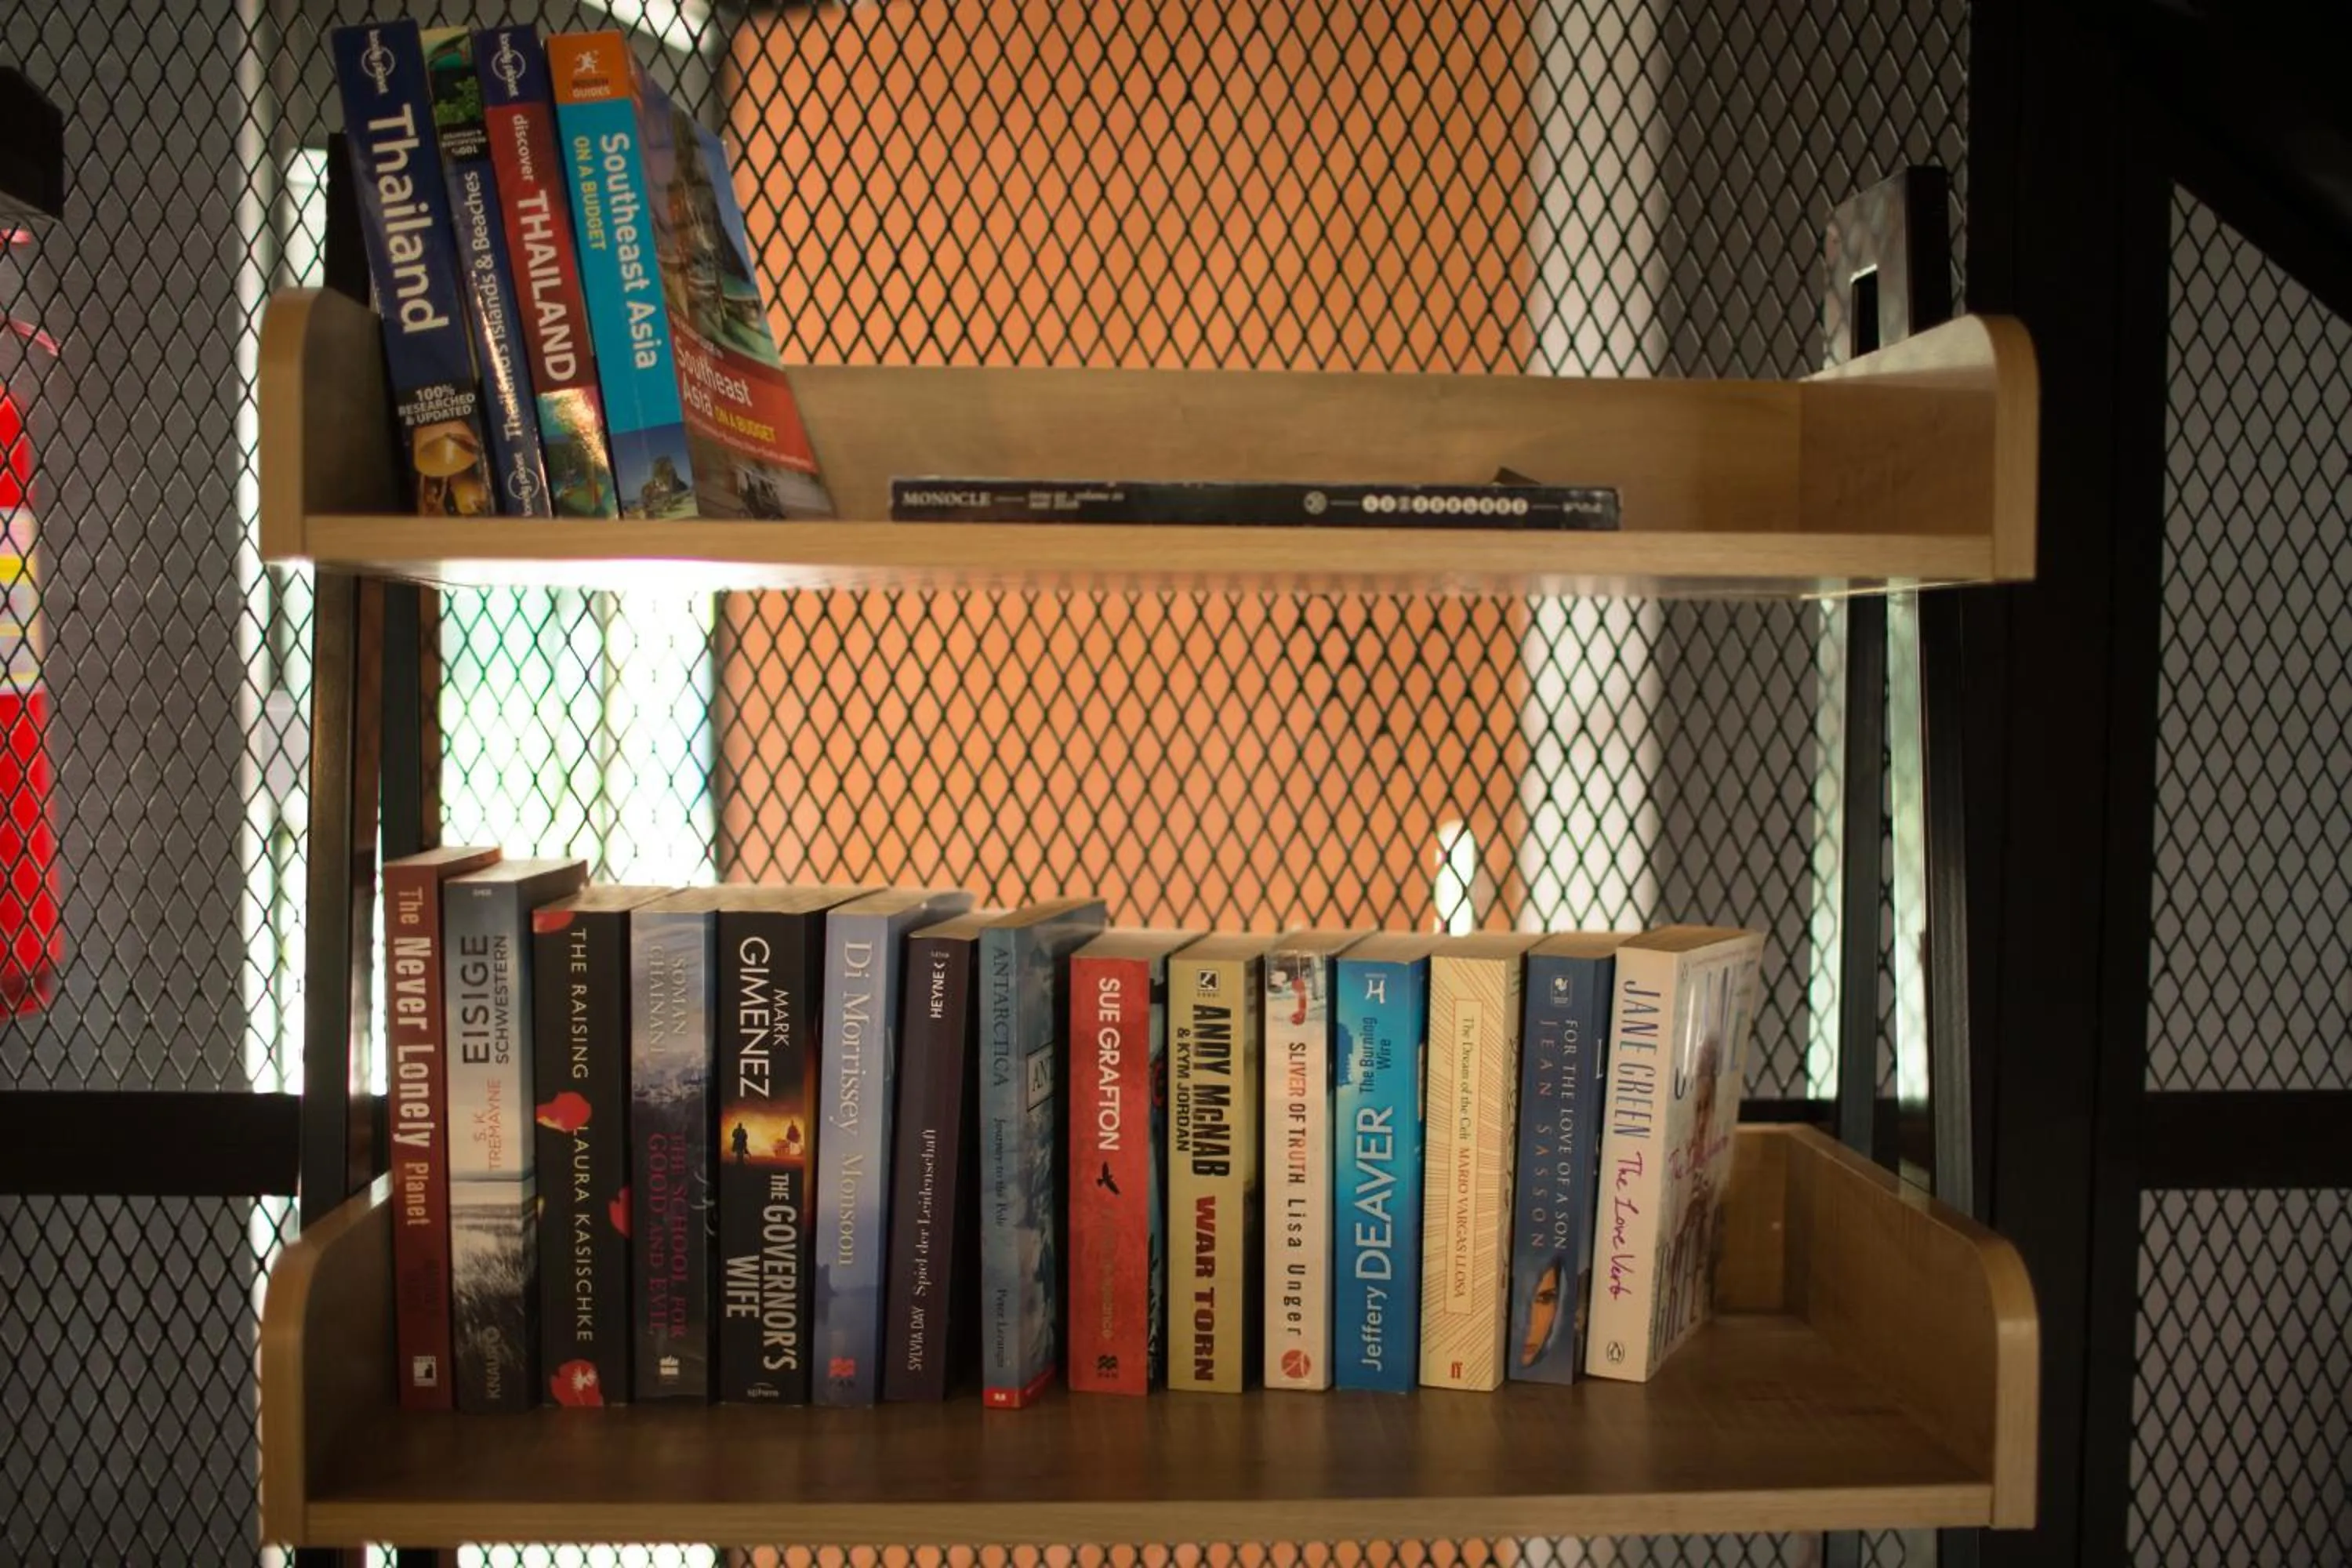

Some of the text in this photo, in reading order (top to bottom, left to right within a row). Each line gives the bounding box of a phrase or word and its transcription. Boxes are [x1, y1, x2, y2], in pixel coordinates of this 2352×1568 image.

[572, 87, 611, 98] GUIDES
[513, 114, 534, 181] discover
[573, 136, 607, 251] ON A BUDGET
[368, 103, 450, 333] Thailand
[600, 132, 661, 369] Southeast Asia
[464, 171, 523, 441] Thailands Islands & Beaches
[517, 189, 576, 382] THAILAND
[398, 393, 475, 417] RESEARCHED
[416, 383, 456, 402] 100%
[416, 405, 472, 423] UPDATED
[675, 336, 753, 407] Southeast
[683, 372, 713, 416] Asia
[902, 492, 992, 507] MONOCLE
[398, 887, 423, 925] The
[394, 937, 432, 1030] Never
[461, 935, 490, 1065] EISIGE
[493, 935, 510, 1065] SCHWESTERN
[571, 928, 589, 1080] THE RAISING
[649, 945, 666, 1054] CHAINANI
[671, 957, 688, 1036] SOMAN
[739, 936, 771, 1098] GIMENEZ
[773, 989, 790, 1047] MARK
[930, 970, 946, 1019] HEYNE
[993, 947, 1011, 1087] ANTARCTICA
[1462, 1016, 1474, 1038] The
[837, 941, 873, 1136] Di Morrissey
[1098, 978, 1120, 1151] SUE GRAFTON
[1192, 1004, 1231, 1076] ANDY
[1359, 1017, 1377, 1094] The Burning
[1377, 1038, 1391, 1070] Wire
[1461, 1042, 1474, 1080] Dream
[394, 1044, 436, 1147] Lonely
[487, 1079, 502, 1171] TREMAYNE
[1177, 1028, 1191, 1152] & KYM JORDAN
[1192, 1084, 1231, 1176] McNAB
[1460, 1097, 1472, 1114] the
[1461, 1081, 1472, 1094] of
[1531, 1020, 1559, 1247] JEAN SASSON
[1457, 1148, 1470, 1194] MARIO
[1553, 1019, 1579, 1250] FOR THE LOVE OF A SON
[1608, 980, 1661, 1301] JANE GREEN The Love Verb
[573, 1126, 593, 1341] LAURA KASISCHKE
[648, 1133, 667, 1334] GOOD AND EVIL
[670, 1131, 688, 1338] THE SCHOOL FOR
[838, 1153, 863, 1267] Monsoon
[1283, 1043, 1307, 1336] SLIVER OF TRUTH Lisa Unger
[1456, 1196, 1469, 1252] VARGAS
[763, 1173, 797, 1370] THE GOVERNOR'S
[915, 1258, 932, 1297] Spiel
[916, 1229, 931, 1254] der
[1355, 1105, 1397, 1371] Jeffery DEAVER
[1453, 1254, 1468, 1298] LLOSA
[726, 1255, 760, 1318] WIFE
[1193, 1196, 1216, 1381] WAR TORN
[908, 1306, 925, 1371] SYLVIA DAY
